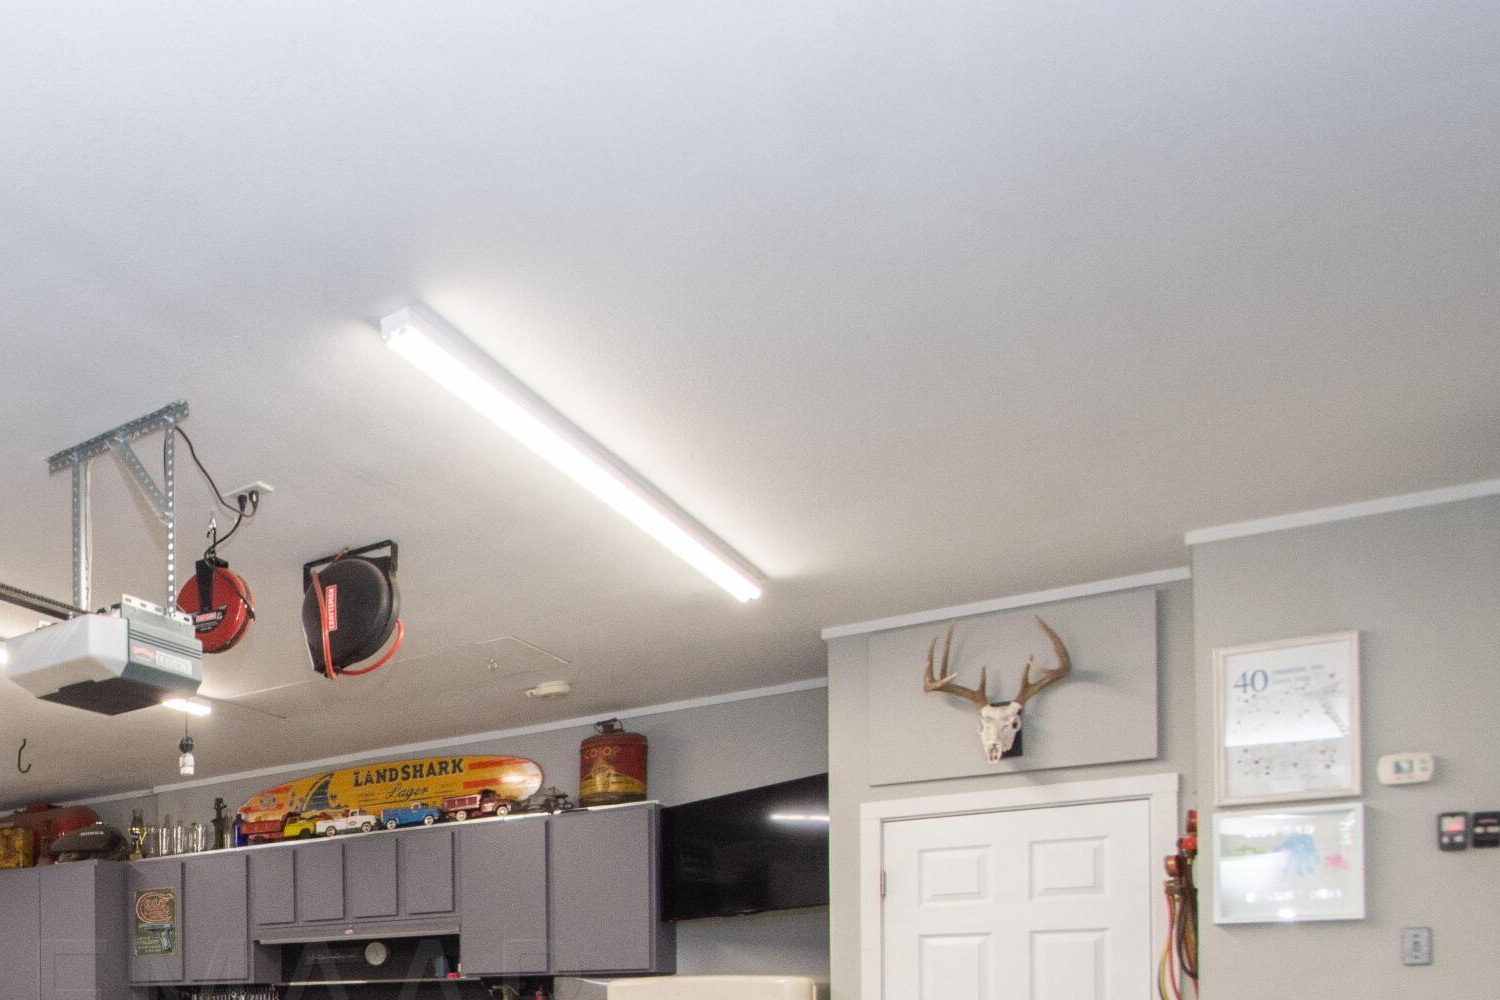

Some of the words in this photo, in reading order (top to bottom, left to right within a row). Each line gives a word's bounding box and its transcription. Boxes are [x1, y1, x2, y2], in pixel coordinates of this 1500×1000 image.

[1233, 668, 1270, 694] 40
[352, 758, 465, 788] LANDSHARK
[385, 784, 431, 803] Lager
